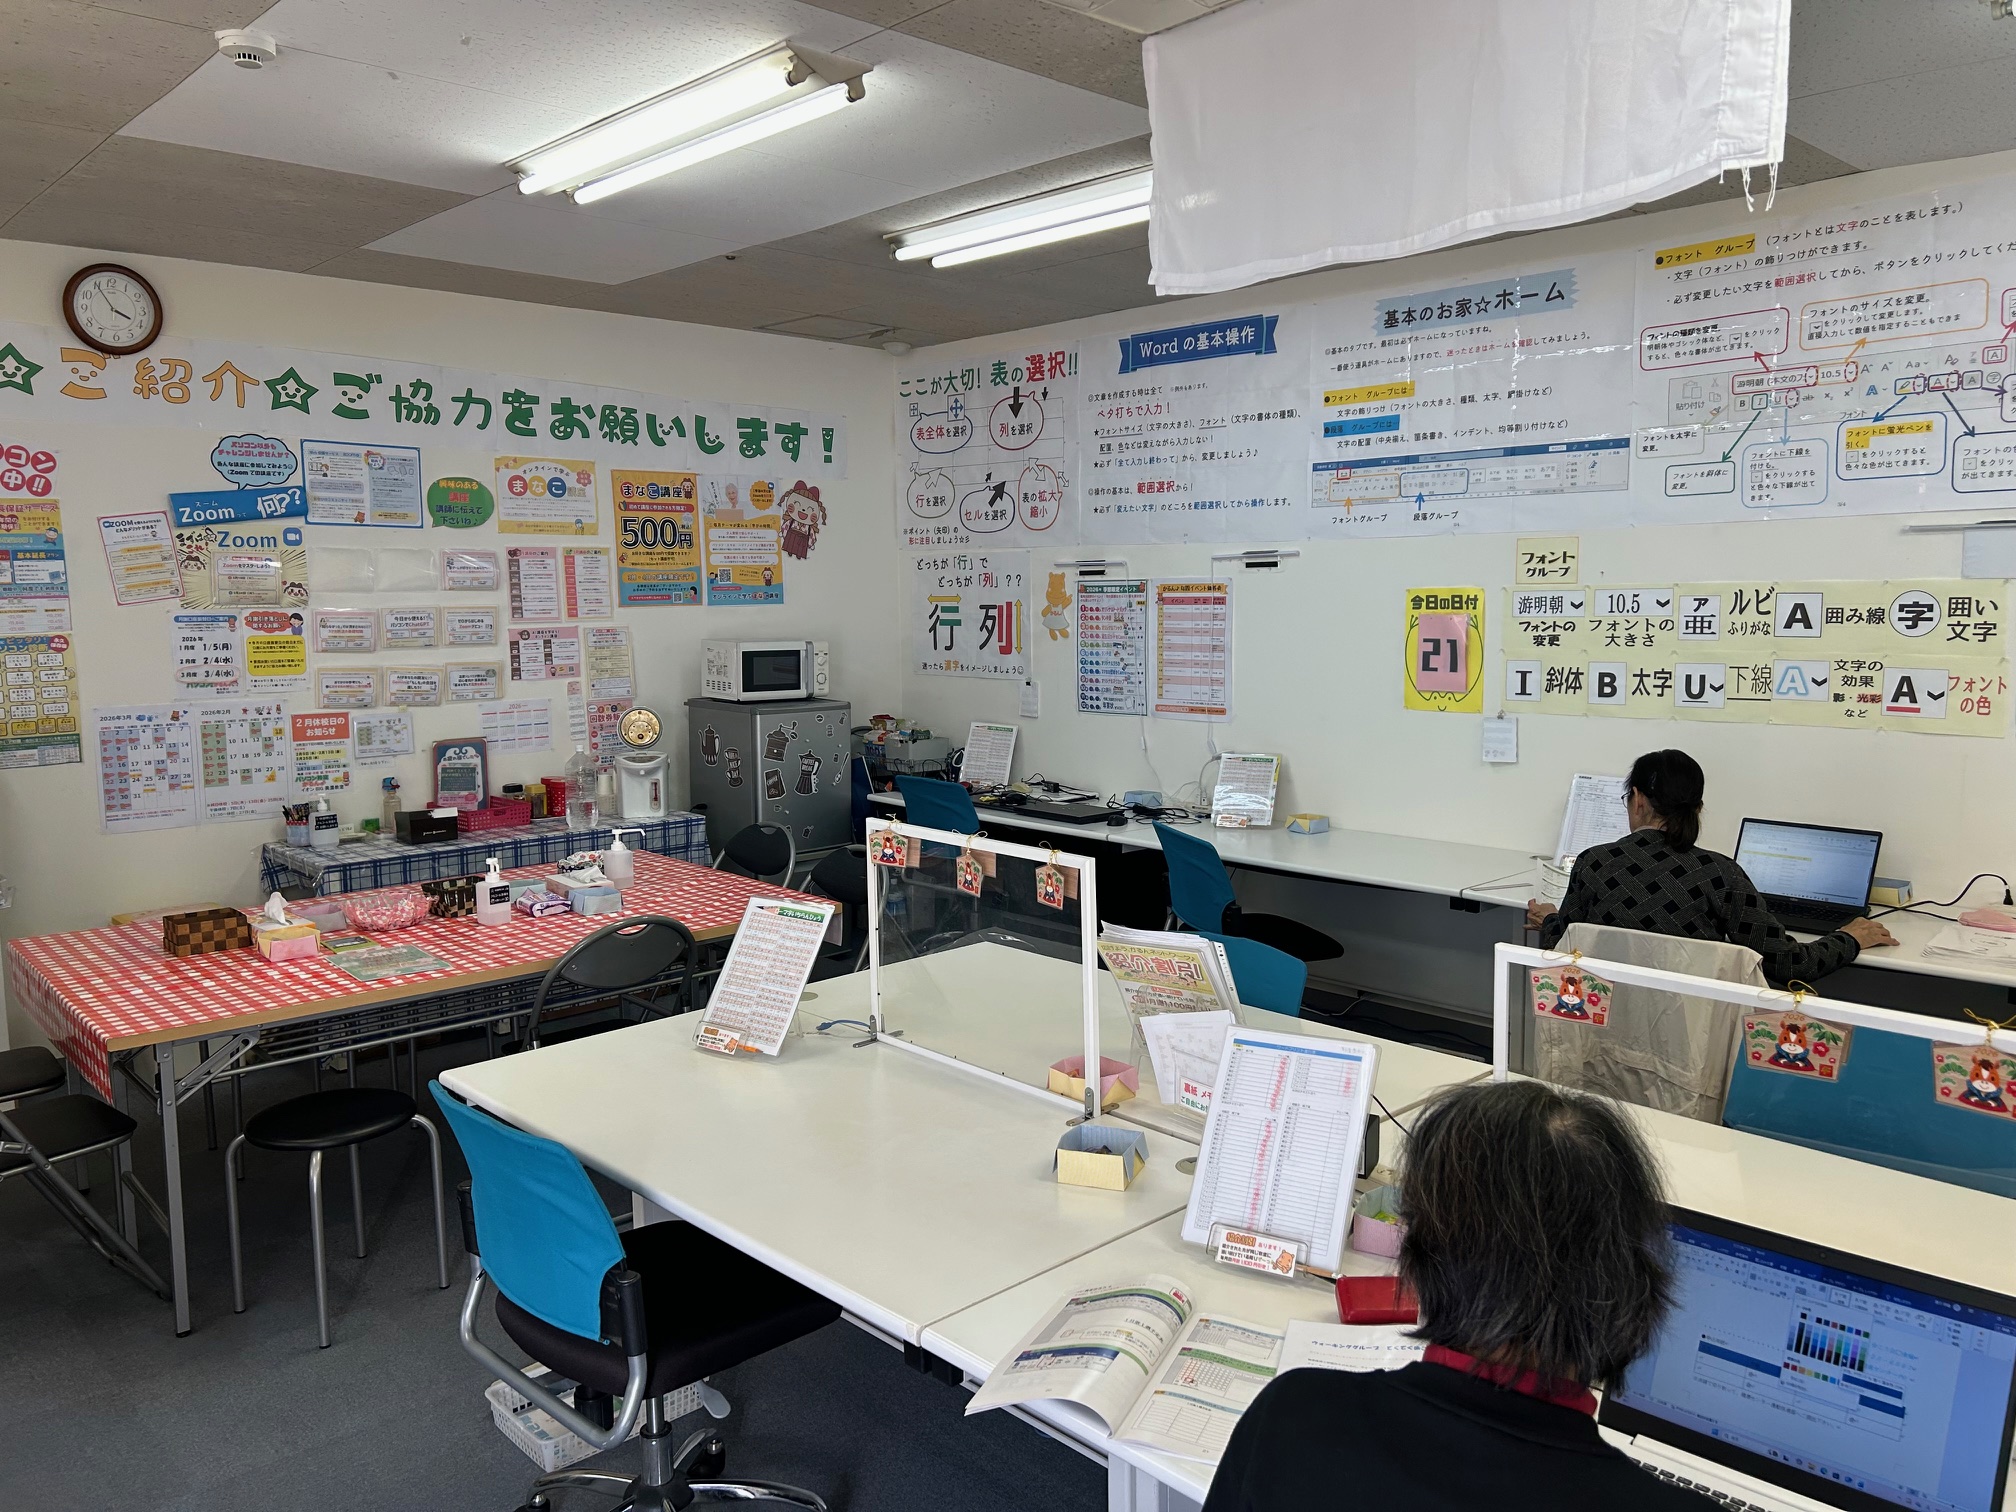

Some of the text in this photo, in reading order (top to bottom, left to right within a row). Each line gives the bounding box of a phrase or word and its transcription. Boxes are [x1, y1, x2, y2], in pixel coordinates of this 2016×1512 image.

[106, 278, 117, 288] 12
[124, 283, 128, 292] 1
[82, 290, 92, 300] 10
[134, 292, 141, 302] 2
[81, 303, 88, 314] 9
[139, 306, 146, 316] 3
[86, 317, 93, 327] 8
[136, 320, 143, 329] 4
[98, 327, 104, 337] 7
[112, 332, 120, 341] 6
[127, 329, 134, 339] 5
[1139, 326, 1256, 358] Word の基本操作
[1820, 370, 1842, 379] 10.5
[916, 423, 1034, 441] 表全体を選択 列を選択
[1862, 447, 1927, 458] をクリックすると
[915, 490, 1058, 522] 行を選択 セルを選択 表の拡大
[1029, 504, 1048, 518] 縮小
[178, 507, 235, 523] Zoom
[1331, 513, 1388, 525] フォントグループ
[1413, 510, 1459, 521] 段落グループ
[217, 530, 278, 548] Zoom
[1521, 550, 1576, 565] フォント
[1525, 566, 1571, 577] グループ
[1410, 594, 1479, 610] 今日の日付
[1518, 596, 1564, 614] 游明朝
[1607, 593, 1640, 614] 10.5
[1728, 586, 1775, 616] ルビ
[1783, 602, 1813, 629] A
[1825, 606, 1886, 625] 囲み線
[1897, 601, 1934, 630] 字
[1947, 596, 1999, 618] 囲い
[928, 601, 1013, 655] 行 列
[1518, 618, 1675, 632] フォントの フォントの
[1683, 614, 1997, 642] 亜 ふりがな 文字
[1532, 634, 1655, 647] 変更 大きさ
[1421, 638, 1459, 673] 21
[1544, 666, 1584, 695] 斜体
[1597, 672, 1618, 698] B
[1631, 668, 1672, 698] 太字
[1685, 674, 1706, 700] U
[1729, 663, 1772, 695] 下線
[1776, 665, 1809, 696] A
[1833, 660, 1883, 672] 文字の
[1890, 675, 1918, 704] A
[1948, 675, 2007, 695] フォント
[1841, 675, 1991, 716] 効果 の色
[1844, 709, 1868, 718] など
[305, 727, 336, 737] お知らせ
[1105, 951, 1204, 981] 紹介割引
[1563, 967, 1581, 975] 2026
[1783, 1013, 1806, 1021] 2026
[1183, 1082, 1198, 1097] 裏紙
